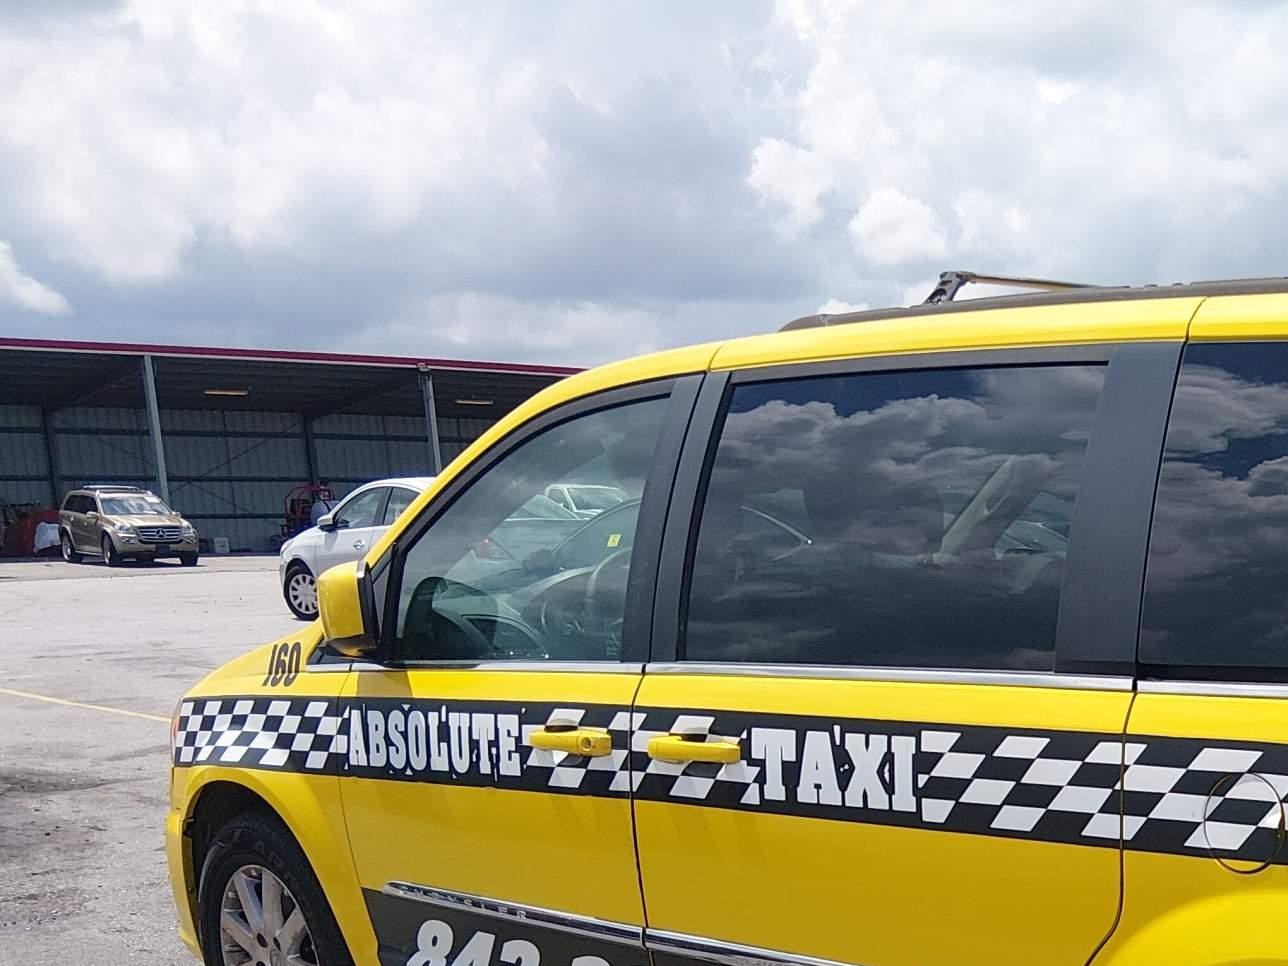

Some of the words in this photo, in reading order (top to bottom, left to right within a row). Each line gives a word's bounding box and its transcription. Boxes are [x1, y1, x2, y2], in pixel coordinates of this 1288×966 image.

[262, 642, 301, 688] 160
[348, 706, 522, 777] ABSOLUTE
[751, 727, 917, 813] TAXI
